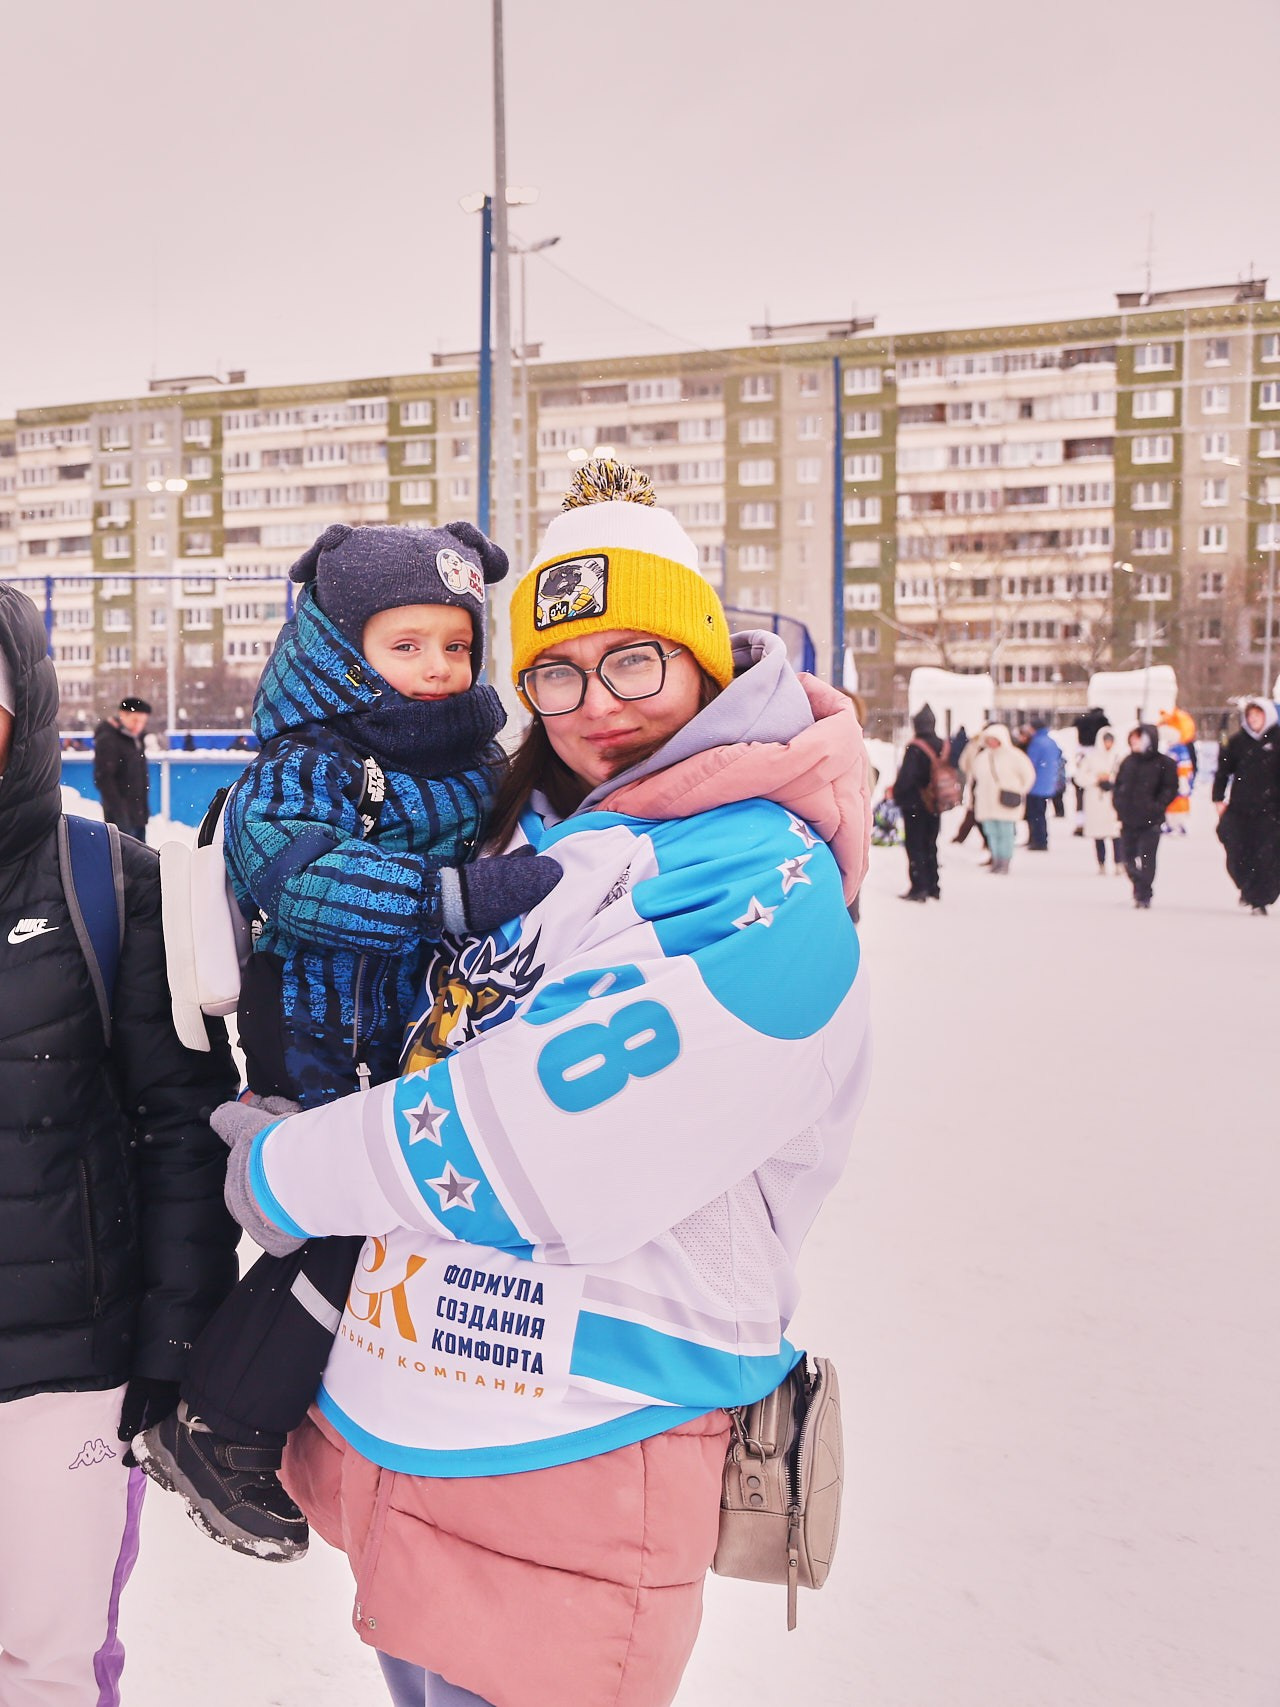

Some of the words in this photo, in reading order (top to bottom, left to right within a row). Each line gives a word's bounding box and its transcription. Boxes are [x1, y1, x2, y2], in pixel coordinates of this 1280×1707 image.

[14, 918, 49, 933] NIKE
[443, 1264, 544, 1306] ФОРМУЛА
[436, 1295, 546, 1340] СОЗДАНИЯ
[340, 1323, 386, 1360] ЛЬНАЯ
[397, 1355, 545, 1399] КОМПАНИЯ
[431, 1328, 544, 1375] КОМФОРТА
